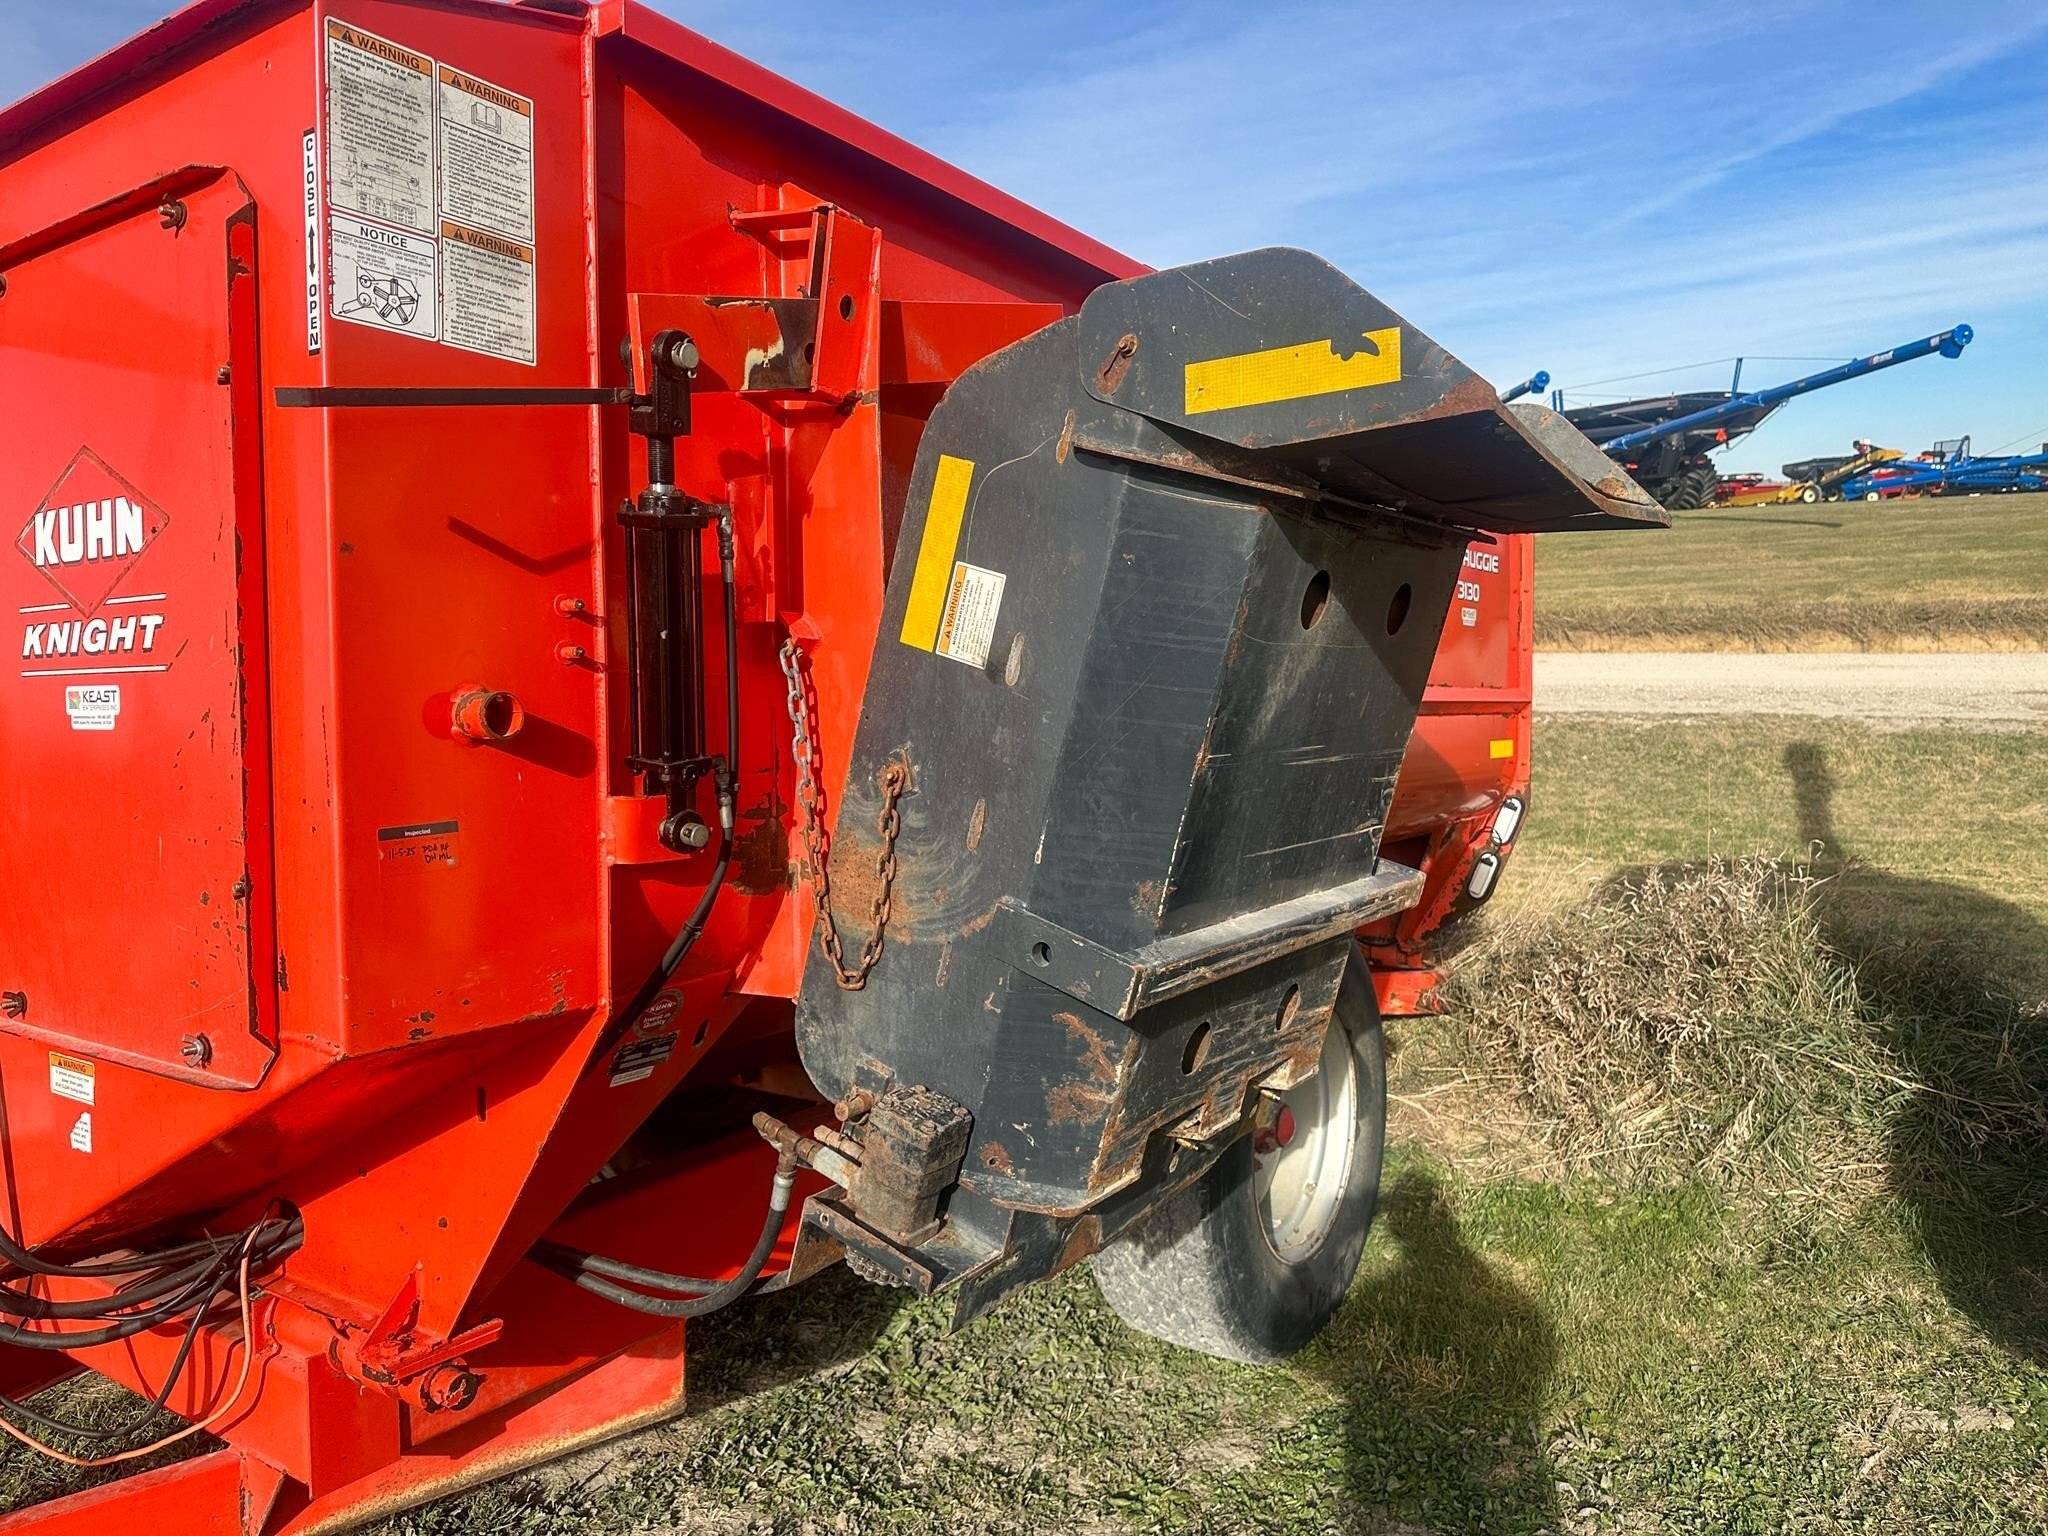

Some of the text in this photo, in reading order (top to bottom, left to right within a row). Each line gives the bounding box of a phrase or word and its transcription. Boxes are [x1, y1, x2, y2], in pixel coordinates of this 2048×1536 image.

[342, 46, 362, 58] prevent
[357, 35, 419, 70] WARNING
[465, 79, 519, 111] WARNING
[450, 124, 467, 136] prevent
[487, 138, 500, 148] injury
[305, 138, 316, 217] CLOSE
[361, 226, 407, 248] NOTICE
[467, 232, 521, 258] WARNING
[309, 284, 319, 346] OPEN
[34, 496, 144, 567] KUHN
[1462, 549, 1499, 573] AUGGIE
[1457, 580, 1480, 602] 3130
[946, 581, 962, 628] WARNING
[22, 614, 165, 659] KNIGHT
[82, 690, 117, 703] KEAST
[404, 828, 431, 837] Inspected
